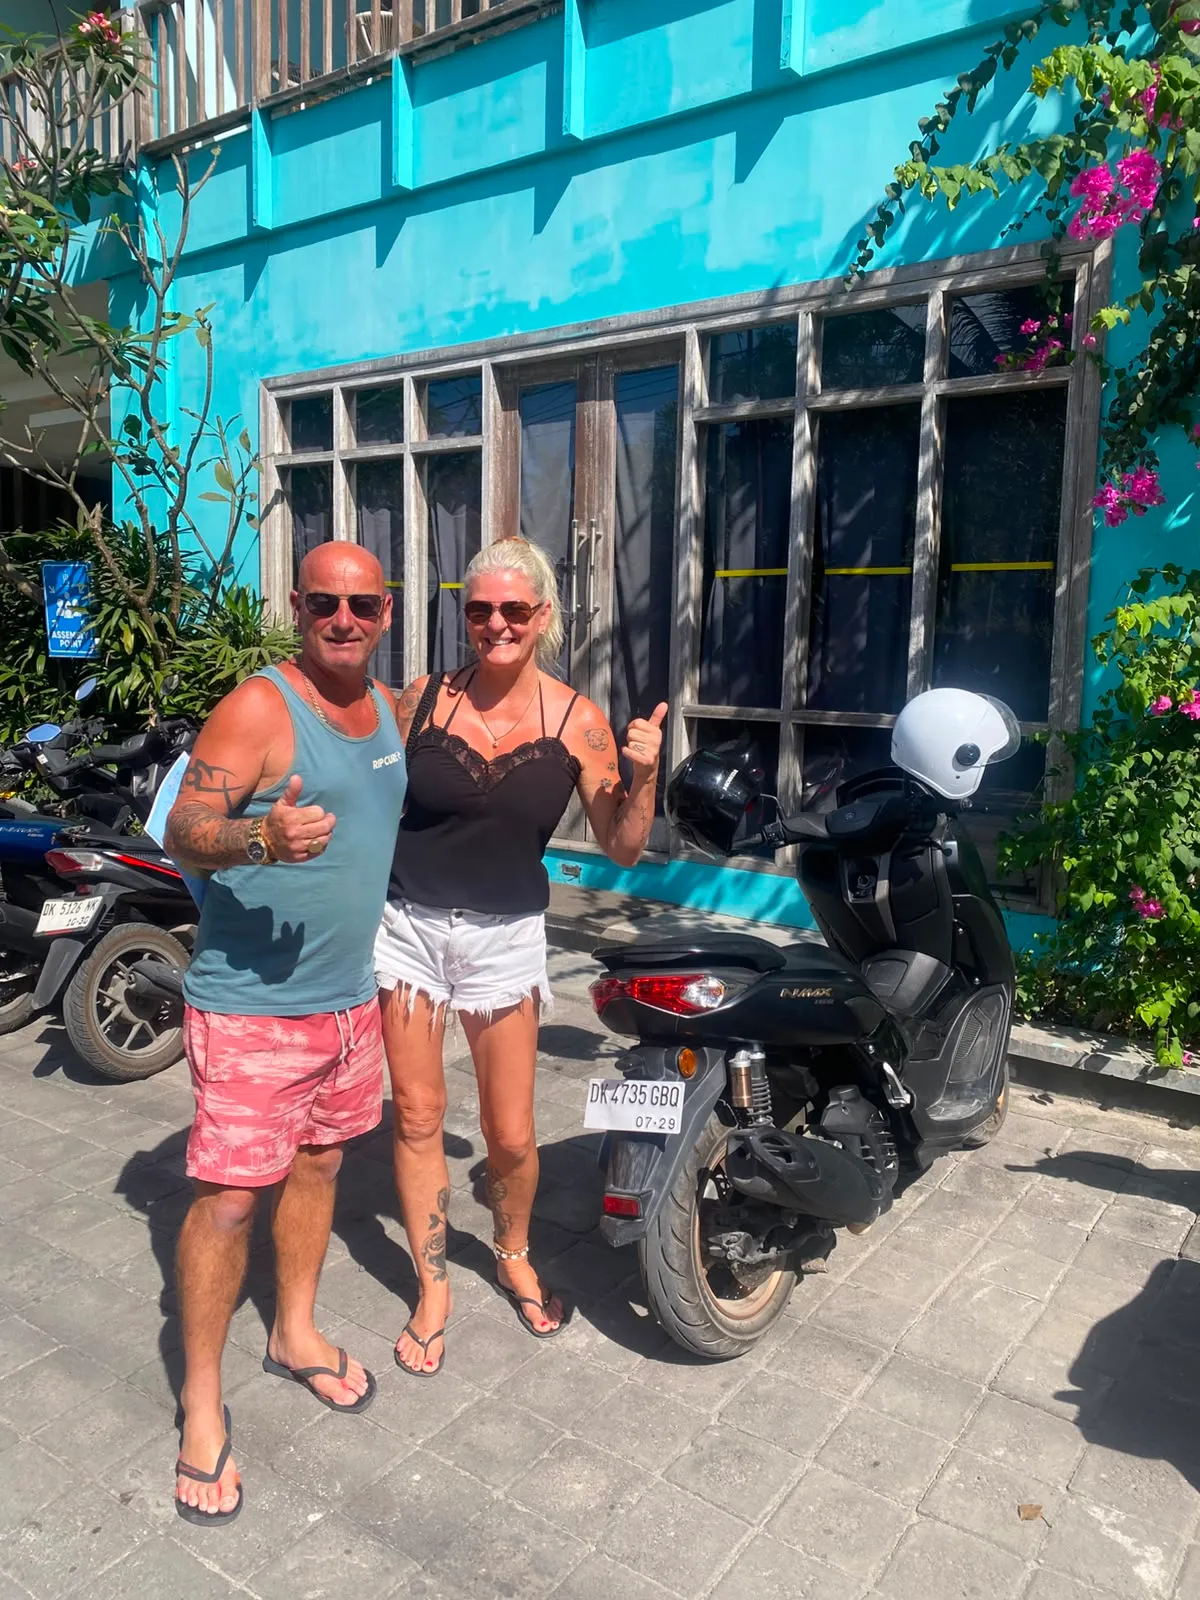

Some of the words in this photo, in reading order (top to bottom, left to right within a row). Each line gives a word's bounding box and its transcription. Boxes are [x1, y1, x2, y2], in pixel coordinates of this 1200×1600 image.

[42, 903, 56, 917] DK
[60, 902, 83, 916] 5126
[590, 1083, 608, 1104] DK
[611, 1083, 648, 1105] 4735
[650, 1085, 680, 1107] GBQ
